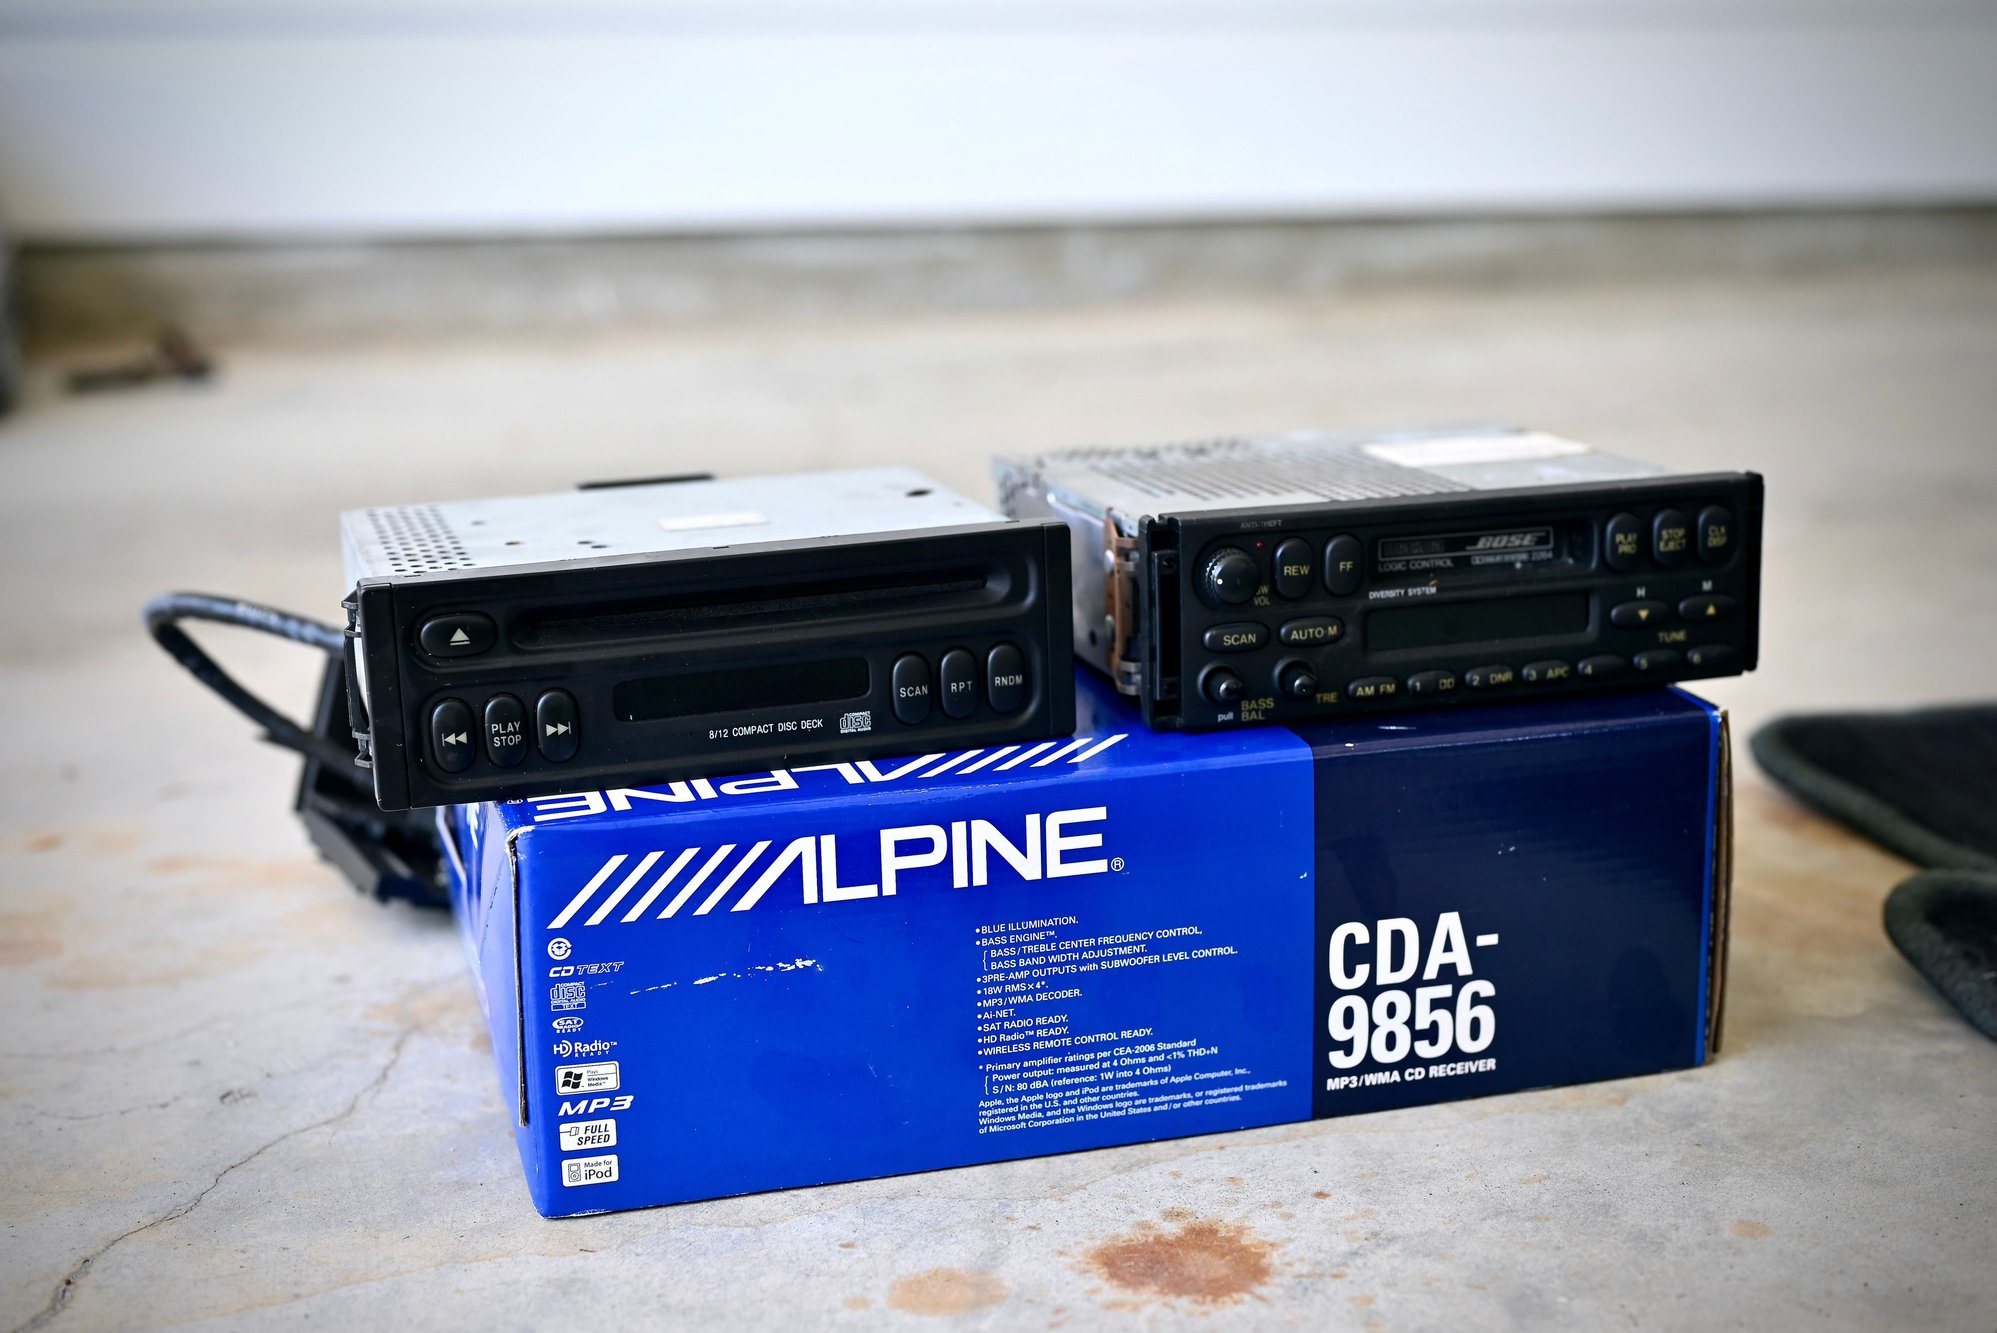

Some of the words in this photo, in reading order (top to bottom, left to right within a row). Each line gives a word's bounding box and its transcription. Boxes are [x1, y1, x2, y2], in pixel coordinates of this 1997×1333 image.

[1661, 527, 1686, 539] STOP
[1472, 532, 1544, 549] BOSE
[1283, 564, 1310, 577] REW
[1339, 561, 1354, 572] FF
[1377, 559, 1407, 573] LOGIC
[1409, 557, 1454, 570] CONTROL
[1368, 588, 1405, 600] DIVERSITY
[1407, 586, 1437, 597] SYSTEM
[1253, 596, 1271, 606] VOL
[1223, 633, 1257, 646] SCAN
[1658, 629, 1686, 643] TUNE
[1528, 670, 1538, 681] 3
[1585, 664, 1593, 676] 4
[950, 680, 973, 693] RPT
[994, 674, 1024, 688] RNDM
[1472, 675, 1480, 686] 2
[899, 683, 929, 698] SCAN
[1356, 685, 1375, 697] AM
[1379, 683, 1396, 695] FM
[1241, 697, 1275, 711] BASS
[1316, 691, 1338, 704] TRE
[1217, 711, 1234, 723] pull
[1241, 709, 1266, 722] BAL
[491, 721, 521, 734] PLAY
[709, 729, 729, 739] 8/12
[732, 723, 774, 737] COMPACT
[778, 721, 798, 732] DISC
[800, 719, 824, 730] DECK
[493, 734, 522, 747] STOP
[981, 923, 1005, 934] BLUE
[1008, 915, 1078, 930] ILLUMINATION.
[981, 935, 1007, 946] BASS
[1058, 938, 1095, 950] CENTER
[1097, 931, 1154, 945] FREQUENCY
[990, 959, 1016, 970] BASS
[1018, 956, 1046, 966] BAND
[1047, 952, 1079, 963] WIDTH
[1081, 944, 1147, 959] ADJUSTMENT.
[1328, 911, 1499, 991] CDA-
[1031, 964, 1077, 977] OUTPUTS
[1078, 962, 1098, 972] with
[1100, 954, 1160, 969] SUBWOOFER
[1162, 951, 1189, 962] LEVEL
[1191, 946, 1237, 958] CONTROL.
[549, 966, 575, 978] CD
[576, 961, 625, 976] TEXT
[983, 985, 1002, 995] 18W
[1035, 988, 1082, 1001] DECODER.
[982, 1008, 1015, 1019] Ai-NET.
[983, 1021, 1001, 1032] SAT
[1003, 1018, 1033, 1029] RADIO
[1035, 1014, 1068, 1025] READY.
[1327, 979, 1496, 1069] 9856
[983, 1034, 997, 1044] HD
[1036, 1026, 1069, 1037] READY.
[983, 1042, 1030, 1055] WIRELESS
[1032, 1037, 1071, 1049] REMOTE
[1074, 1032, 1118, 1044] CONTROL
[1120, 1027, 1152, 1038] READY.
[574, 1050, 610, 1058] READY
[985, 1062, 1020, 1072] Primary
[1022, 1056, 1062, 1067] amplifier
[1064, 1052, 1094, 1062] ratings
[1096, 1050, 1111, 1060] per
[1113, 1043, 1155, 1056] CEA-2006
[1156, 1038, 1196, 1050] Standard
[992, 1072, 1020, 1082] Power
[1022, 1068, 1054, 1078] output:
[1056, 1061, 1099, 1074] measured
[1101, 1060, 1110, 1068] at
[1112, 1058, 1118, 1066] 4
[1119, 1056, 1146, 1066] Ohms
[1147, 1052, 1164, 1062] and
[1404, 1066, 1425, 1081] CD
[1429, 1058, 1496, 1078] RECEIVER
[1016, 1082, 1027, 1090] 80
[1029, 1079, 1048, 1089] dBA
[1050, 1074, 1097, 1087] (reference:
[1099, 1071, 1114, 1080] 1W
[1115, 1070, 1133, 1078] into
[1142, 1064, 1171, 1074] Ohms)
[1005, 1096, 1019, 1104] the
[1020, 1093, 1044, 1105] Apple
[1045, 1091, 1063, 1101] logo
[1064, 1088, 1080, 1096] and
[1081, 1085, 1099, 1094] iPod
[1115, 1078, 1158, 1090] trademarks
[1159, 1076, 1168, 1084] of
[1169, 1074, 1192, 1083] Apple
[1205, 1084, 1243, 1097] registered
[1244, 1079, 1287, 1090] trademarks
[558, 1095, 635, 1117] MP3
[978, 1104, 1018, 1119] registered
[1029, 1102, 1042, 1110] the
[1062, 1097, 1077, 1106] and
[1079, 1095, 1100, 1103] other
[978, 1115, 1016, 1125] Windows
[1045, 1108, 1061, 1116] and
[1076, 1102, 1113, 1112] Windows
[1115, 1100, 1132, 1109] logo
[978, 1126, 987, 1134] of
[988, 1121, 1026, 1132] Microsoft
[1027, 1116, 1074, 1127] Corporation
[1100, 1108, 1126, 1118] United
[1127, 1106, 1151, 1114] States
[1182, 1099, 1203, 1107] other
[584, 1123, 610, 1135] FULL
[577, 1133, 611, 1146] SPEED
[584, 1160, 603, 1168] Made
[584, 1167, 612, 1181] iPod
